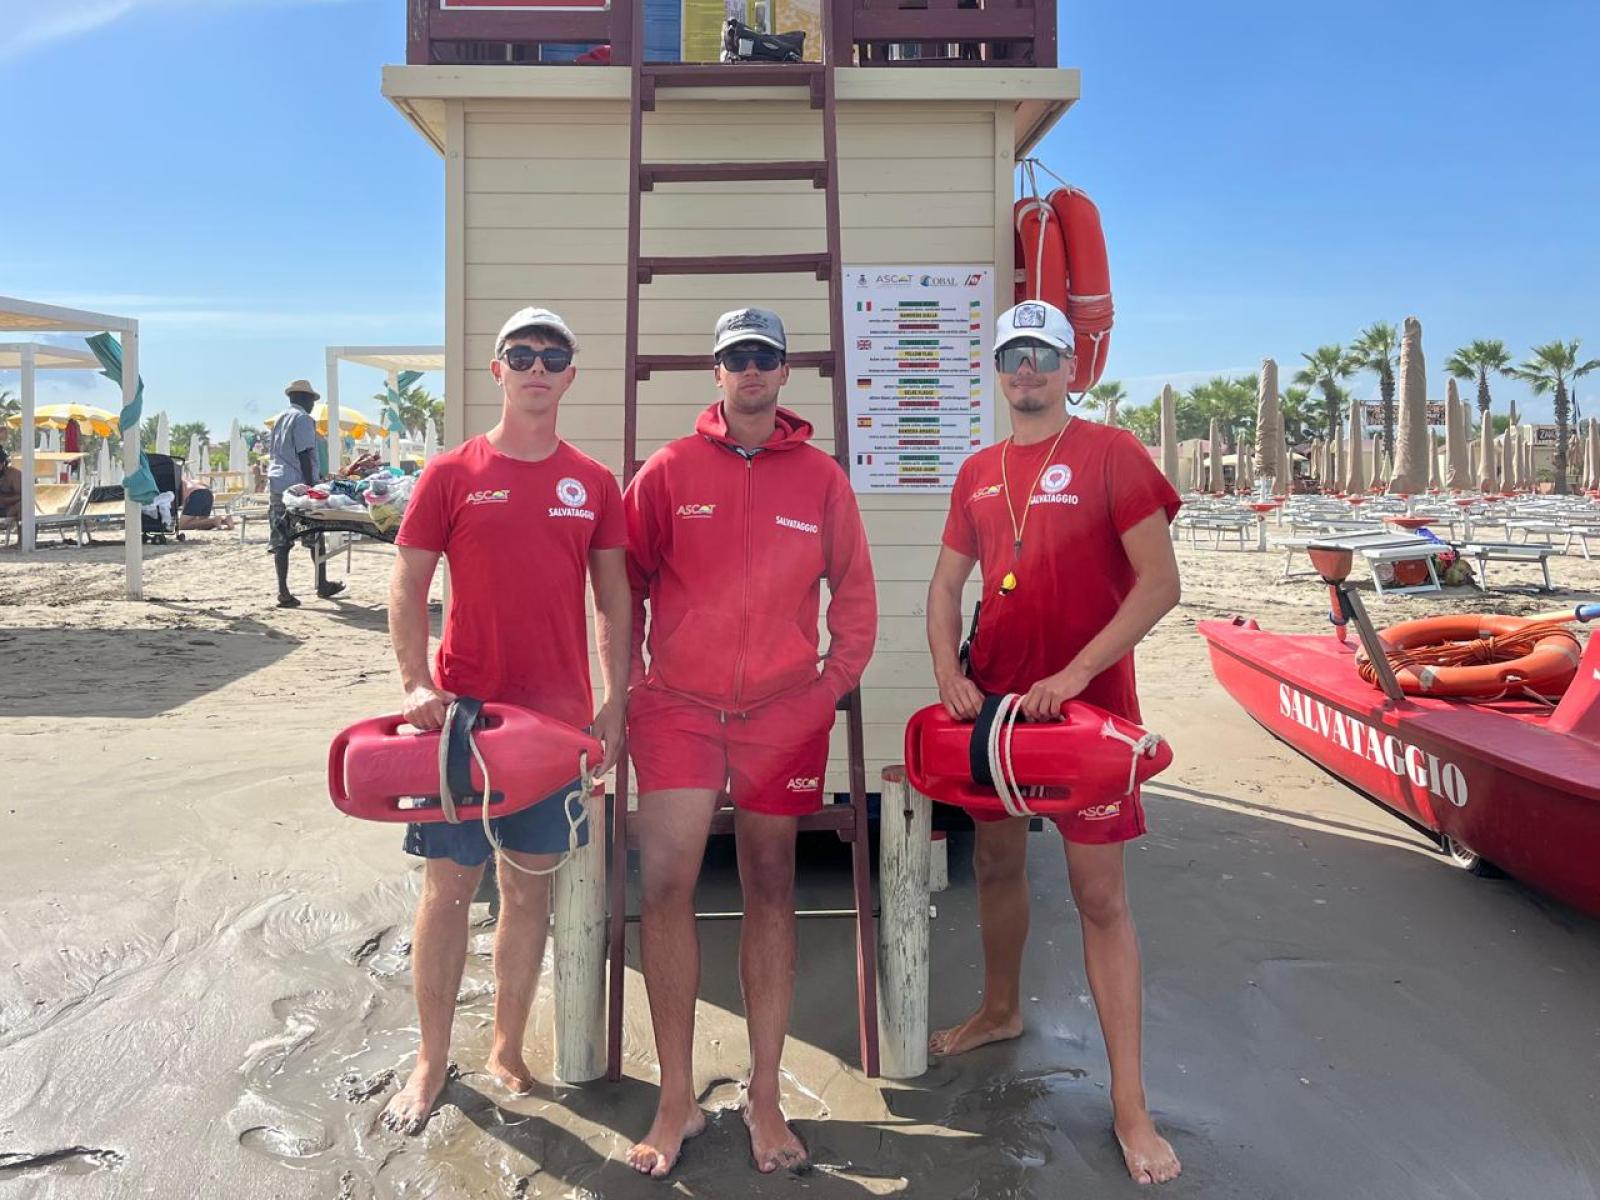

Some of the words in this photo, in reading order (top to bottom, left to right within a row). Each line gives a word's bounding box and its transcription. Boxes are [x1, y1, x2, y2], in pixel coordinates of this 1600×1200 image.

[466, 489, 511, 503] ASCOT
[548, 507, 595, 521] SALVATAGGIO
[676, 504, 717, 516] ASCOT
[775, 515, 818, 534] SALVATAGGIO
[1279, 682, 1469, 807] SALVATAGGIO
[786, 776, 820, 790] ASCOT
[1078, 800, 1122, 817] ASCOT
